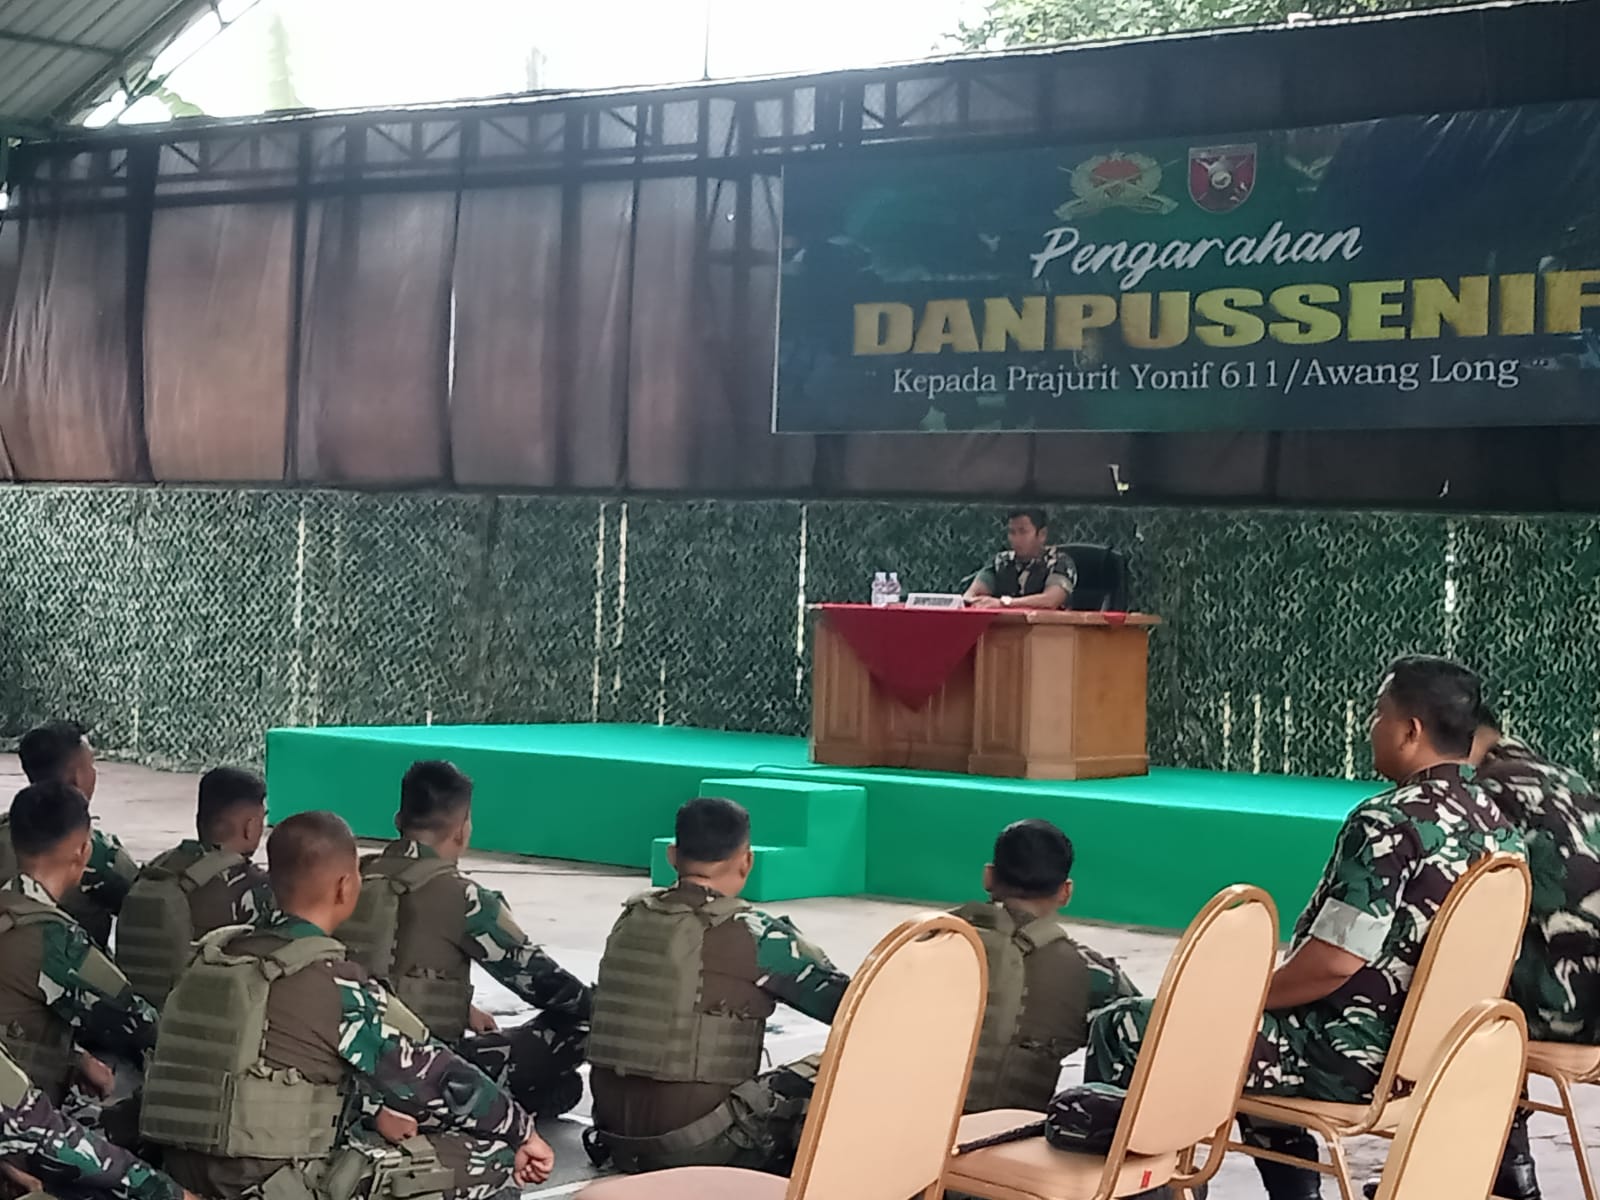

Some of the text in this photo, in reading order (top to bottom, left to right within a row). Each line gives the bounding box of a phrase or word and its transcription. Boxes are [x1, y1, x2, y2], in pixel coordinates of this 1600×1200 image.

[1030, 221, 1362, 290] Pengarahan
[854, 269, 1600, 356] DANPUSSENIF
[893, 354, 1519, 399] Kepada Prajurit Yonif 611/Awang Long
